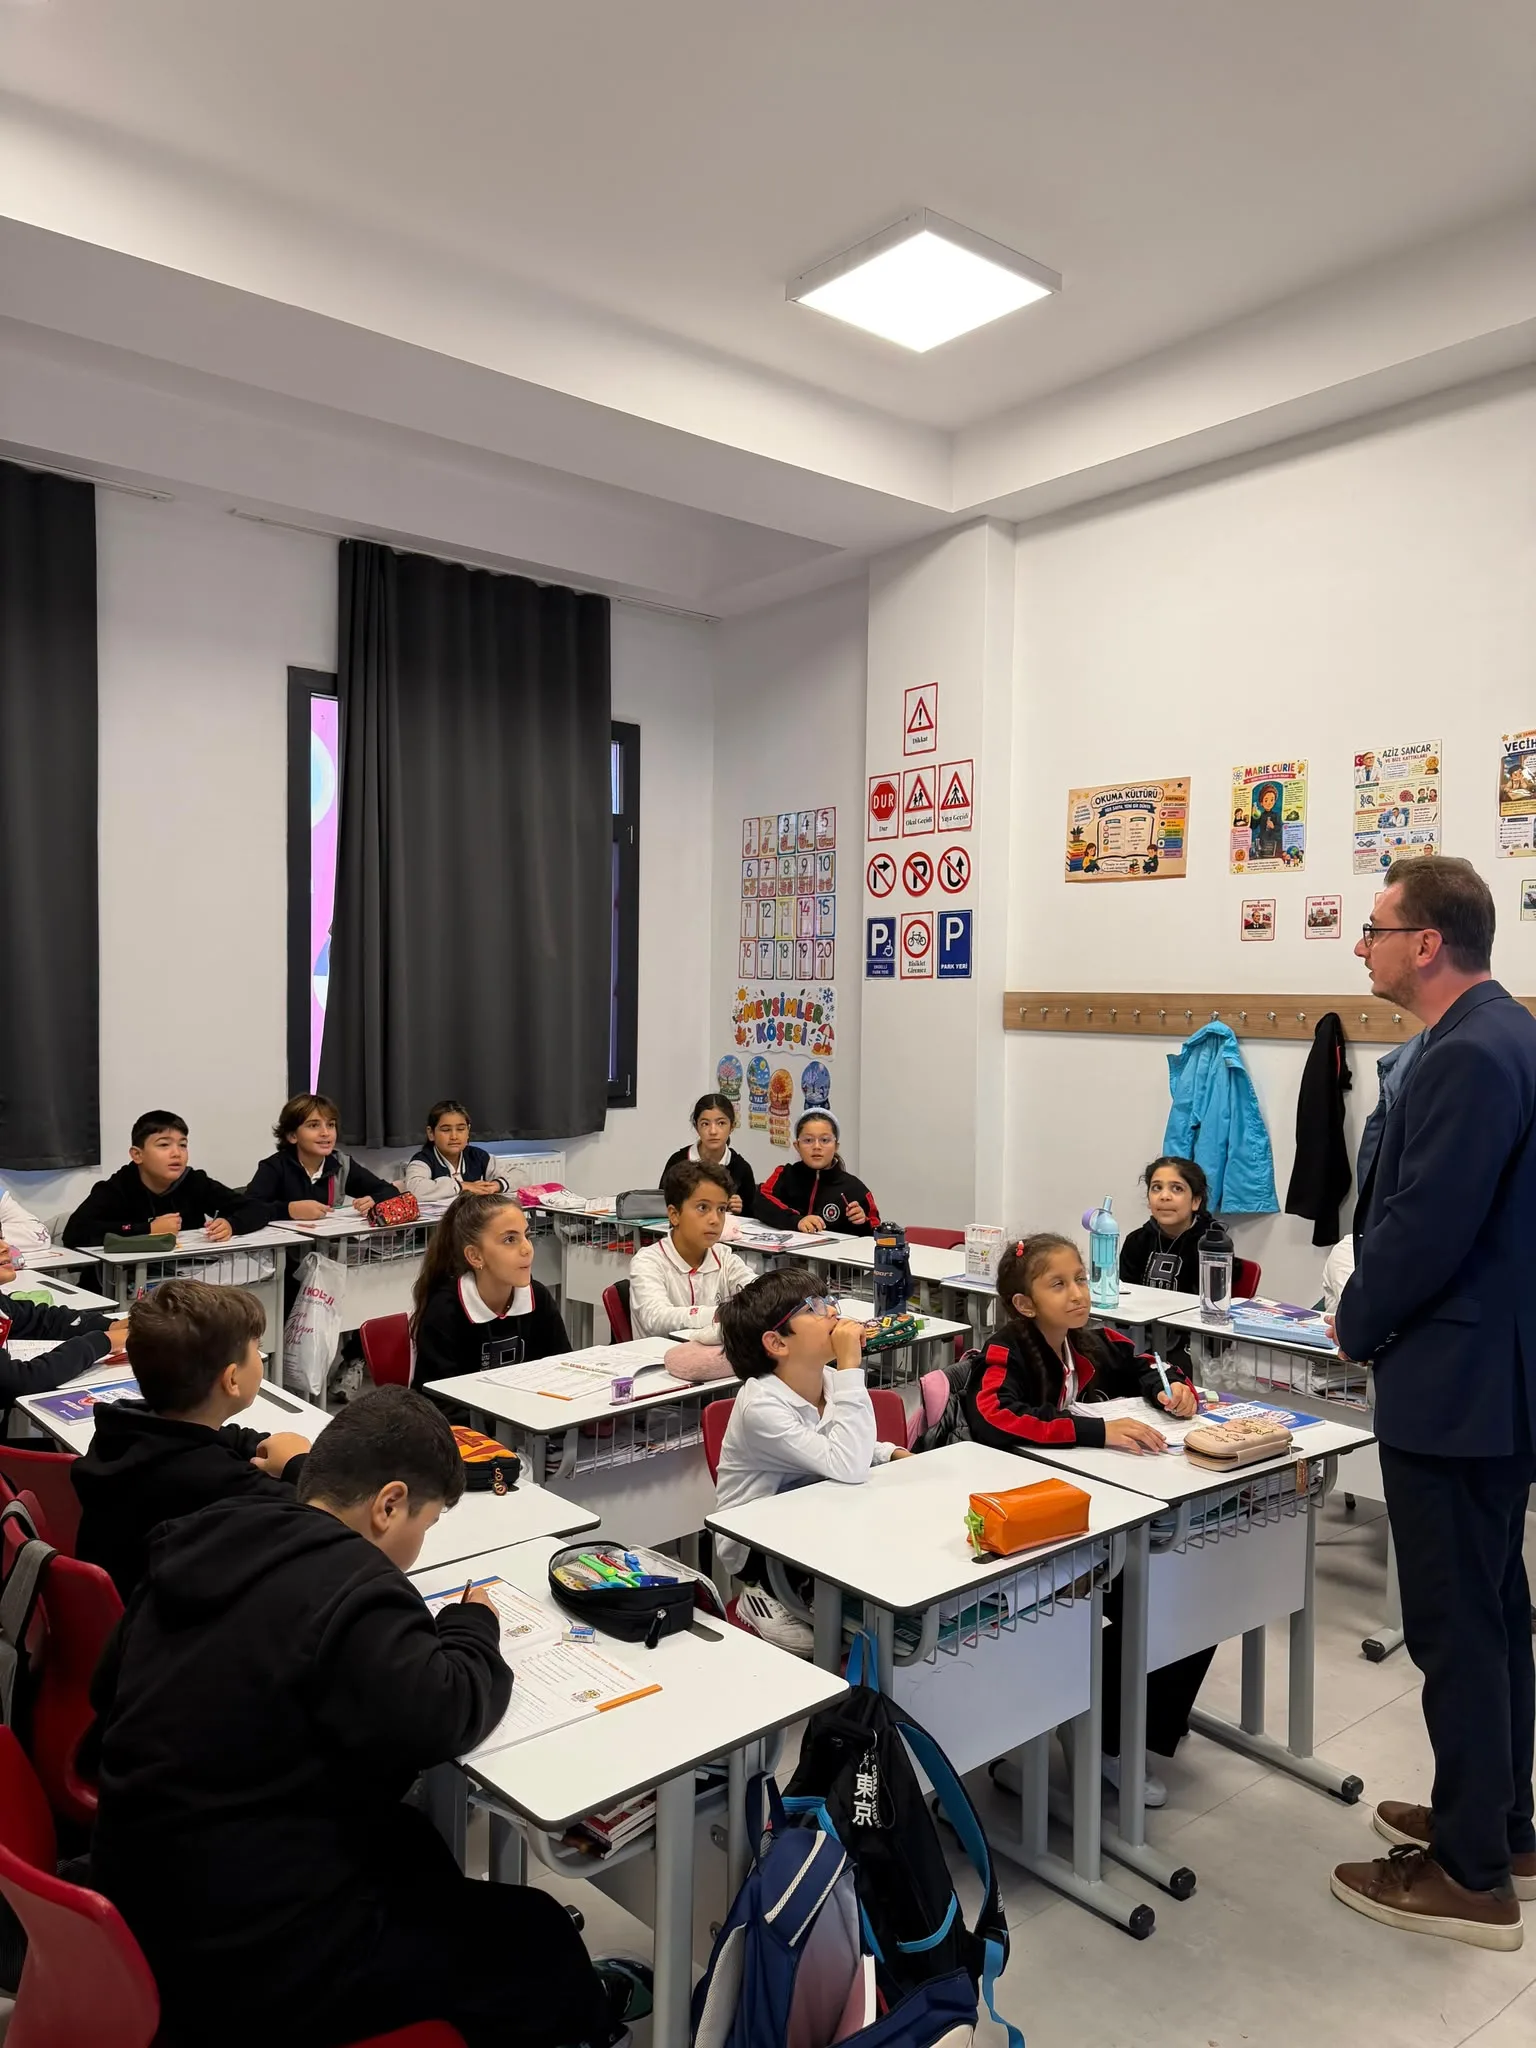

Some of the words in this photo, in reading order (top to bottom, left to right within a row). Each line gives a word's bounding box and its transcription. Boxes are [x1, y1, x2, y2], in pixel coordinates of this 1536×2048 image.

[912, 736, 928, 744] Dikkat
[1382, 747, 1399, 758] AZİZ
[1401, 744, 1432, 755] SANCAR
[1244, 765, 1270, 778] MARIE
[1272, 763, 1296, 773] CURIE
[873, 793, 894, 810] DUR
[1095, 793, 1123, 805] OKUMA
[1126, 789, 1158, 800] KÜLTÜRÜ
[764, 820, 772, 835] 2
[783, 817, 790, 833] 3
[802, 815, 809, 830] 4
[821, 811, 828, 828] 5
[746, 863, 752, 877] 6
[764, 861, 770, 876] 7
[784, 860, 790, 874] 8
[802, 858, 808, 875] 9
[819, 856, 830, 872] 10
[761, 902, 772, 918] 12
[800, 900, 810, 916] 14
[818, 898, 830, 916] 15
[872, 924, 888, 956] P
[946, 917, 964, 950] P
[743, 943, 752, 958] 16
[760, 943, 769, 958] 17
[780, 943, 788, 958] 18
[798, 942, 808, 958] 19
[816, 942, 832, 958] 20
[744, 992, 824, 1025] MEVSİMLER
[756, 1018, 808, 1046] KÖŞESİ
[852, 1772, 872, 1826] 東京
